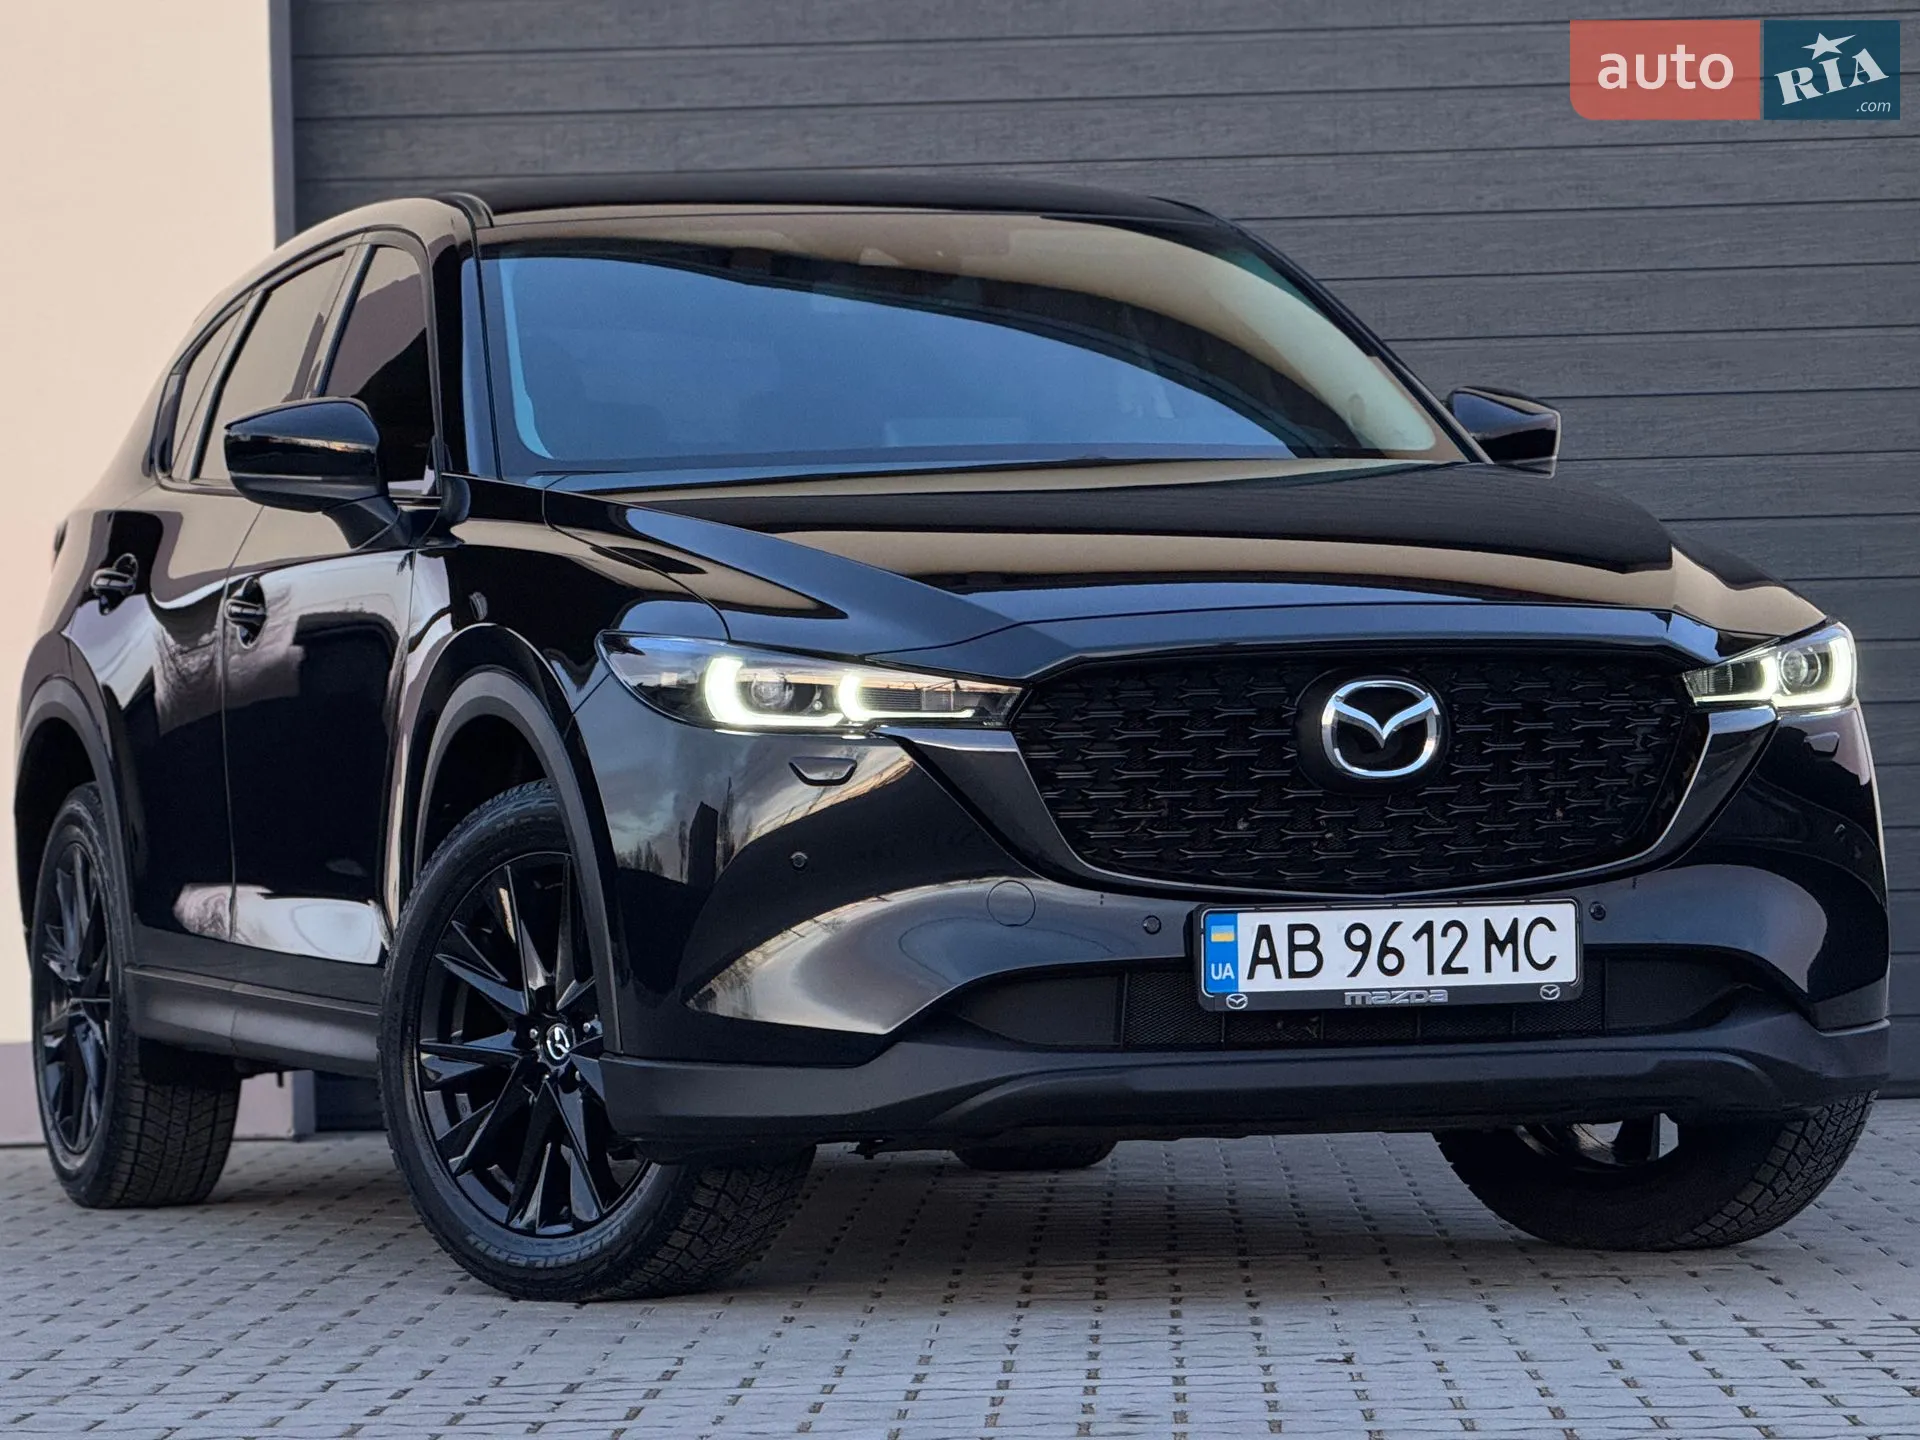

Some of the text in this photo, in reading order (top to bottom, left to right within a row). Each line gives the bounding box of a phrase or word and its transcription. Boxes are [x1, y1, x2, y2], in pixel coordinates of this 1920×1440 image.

[1246, 916, 1558, 980] AB 9612 MC
[1211, 963, 1235, 981] UA
